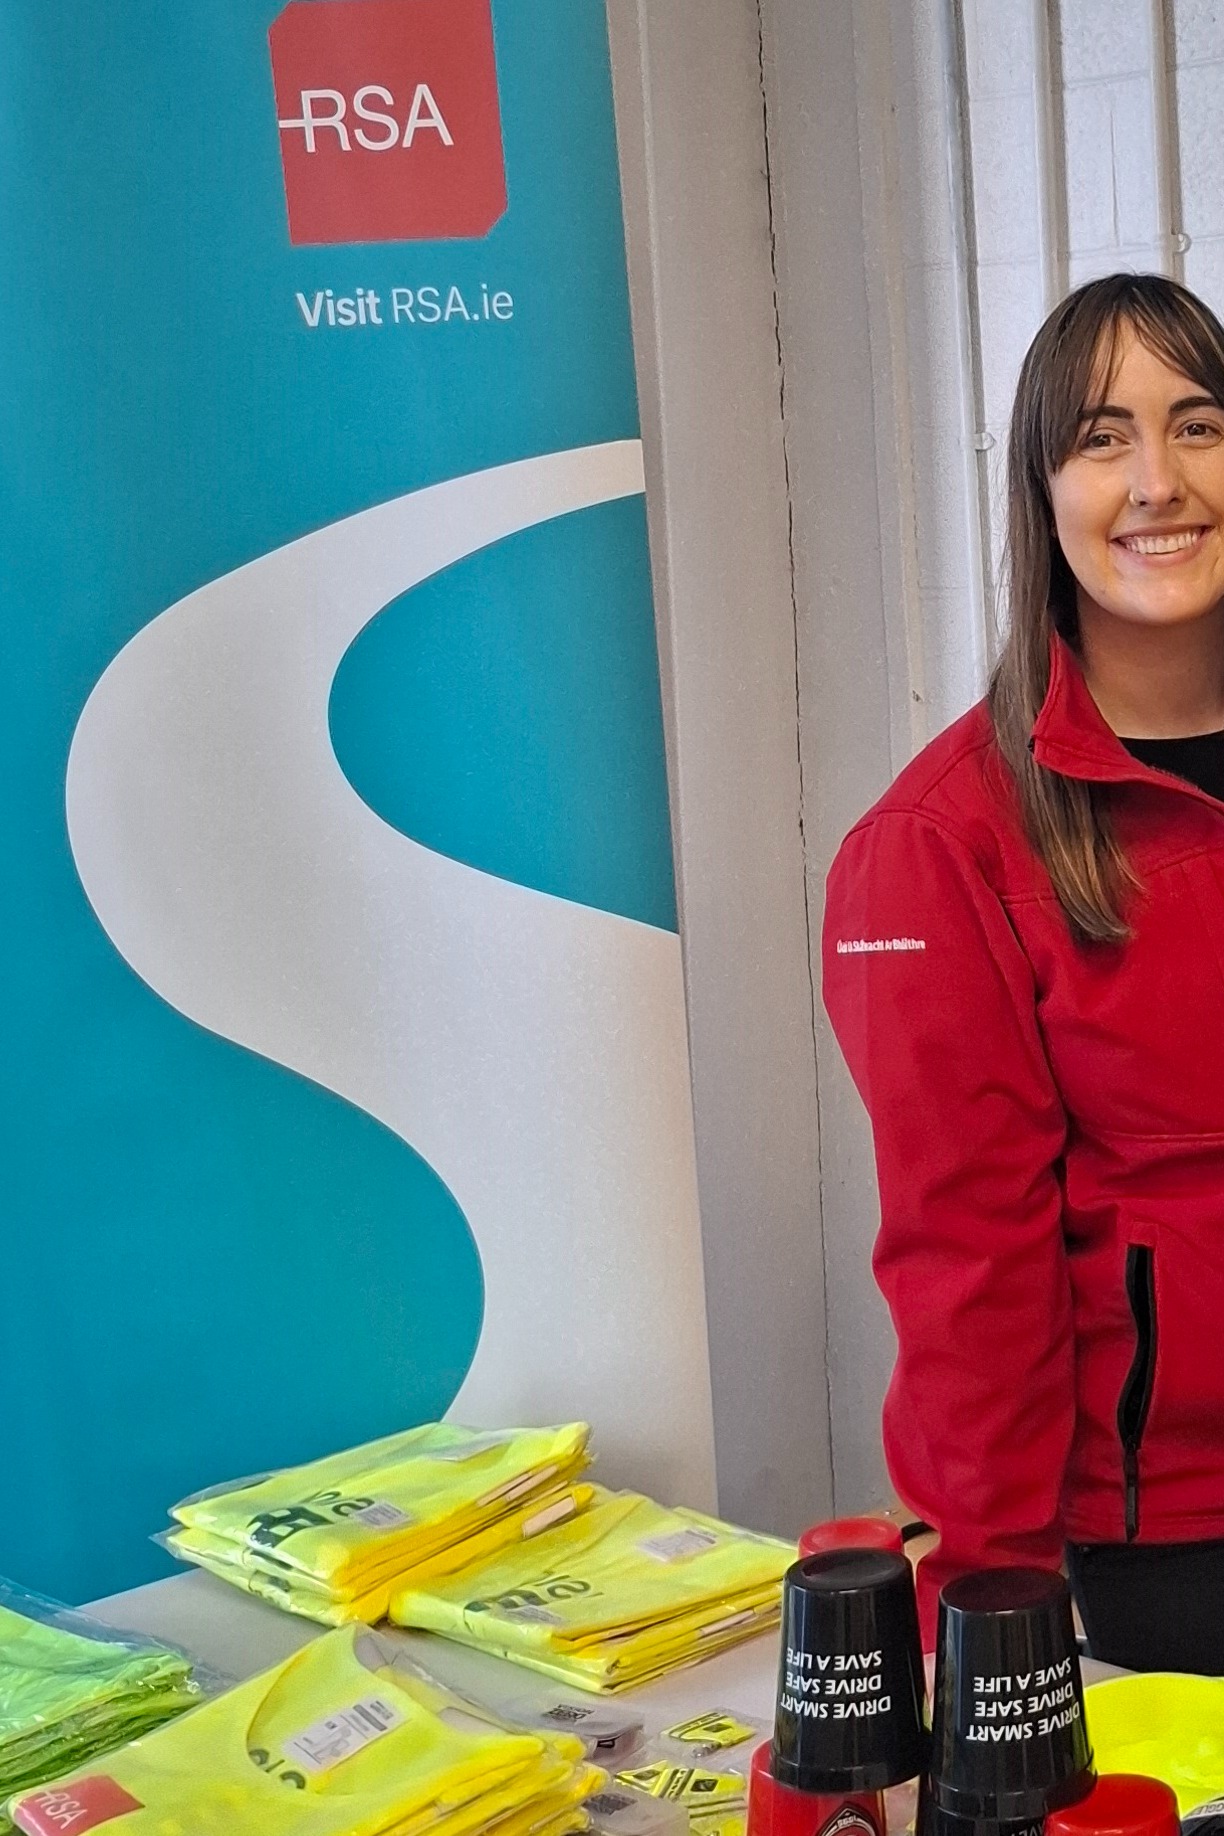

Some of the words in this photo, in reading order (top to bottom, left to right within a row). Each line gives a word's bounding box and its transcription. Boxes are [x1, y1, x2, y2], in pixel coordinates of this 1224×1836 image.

[279, 84, 454, 153] RSA
[296, 288, 383, 327] Visit
[391, 283, 514, 324] RSA.ie
[786, 1647, 813, 1669] LIFE
[816, 1655, 831, 1671] A
[833, 1650, 882, 1671] SAVE
[785, 1671, 821, 1694] SAFE
[1016, 1673, 1031, 1690] A
[1035, 1656, 1072, 1687] SAVE
[824, 1674, 882, 1695] DRIVE
[973, 1676, 1012, 1693] LIFE
[780, 1692, 829, 1719] SMART
[832, 1695, 891, 1719] DRIVE
[974, 1699, 1023, 1718] SAFE
[1027, 1681, 1074, 1713] DRIVE
[1038, 1701, 1081, 1736] DRIVE
[965, 1722, 1033, 1742] SMART
[35, 1791, 88, 1830] RSA
